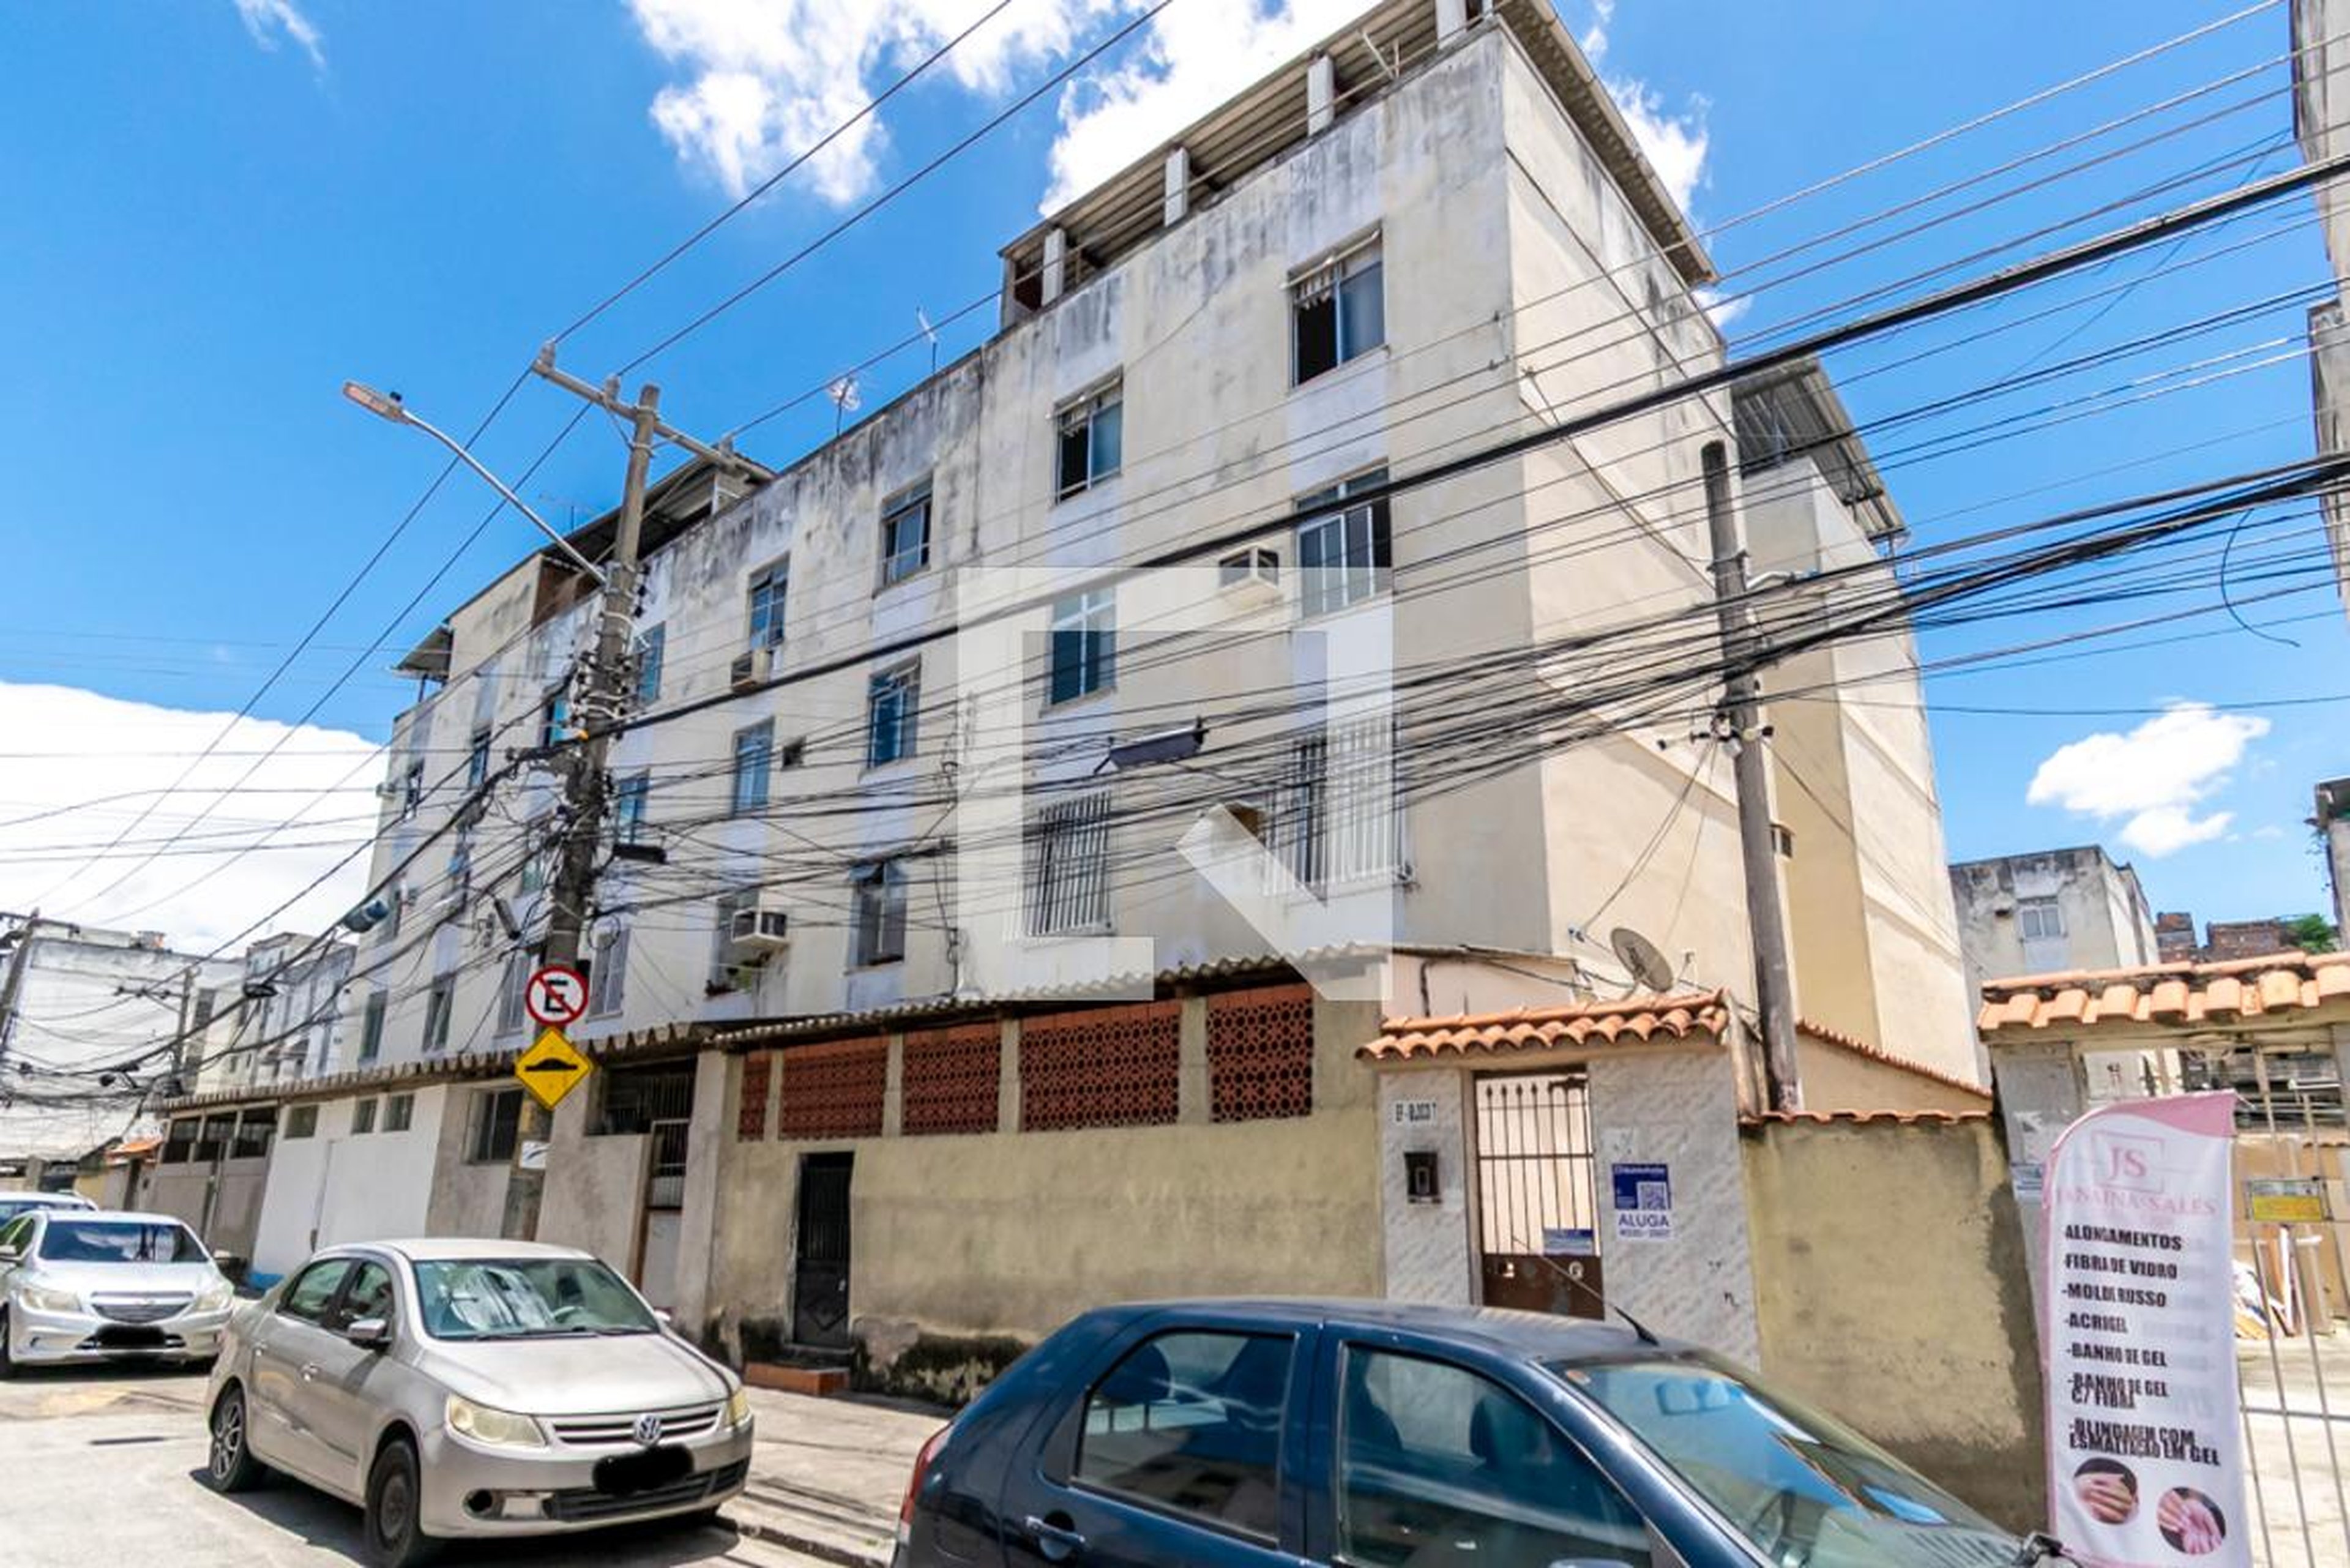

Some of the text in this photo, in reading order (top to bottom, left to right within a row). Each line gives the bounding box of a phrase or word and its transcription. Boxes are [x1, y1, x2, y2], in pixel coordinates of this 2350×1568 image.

[544, 979, 569, 1012] E
[2108, 1145, 2147, 1181] JS
[1618, 1213, 1669, 1228] ALUGA
[2065, 1253, 2177, 1280] FIBRA DE VIDRO
[2124, 1348, 2140, 1364] DE
[2142, 1350, 2168, 1367] GEL
[2145, 1381, 2170, 1397] GEL
[2190, 1445, 2221, 1466] GEL
